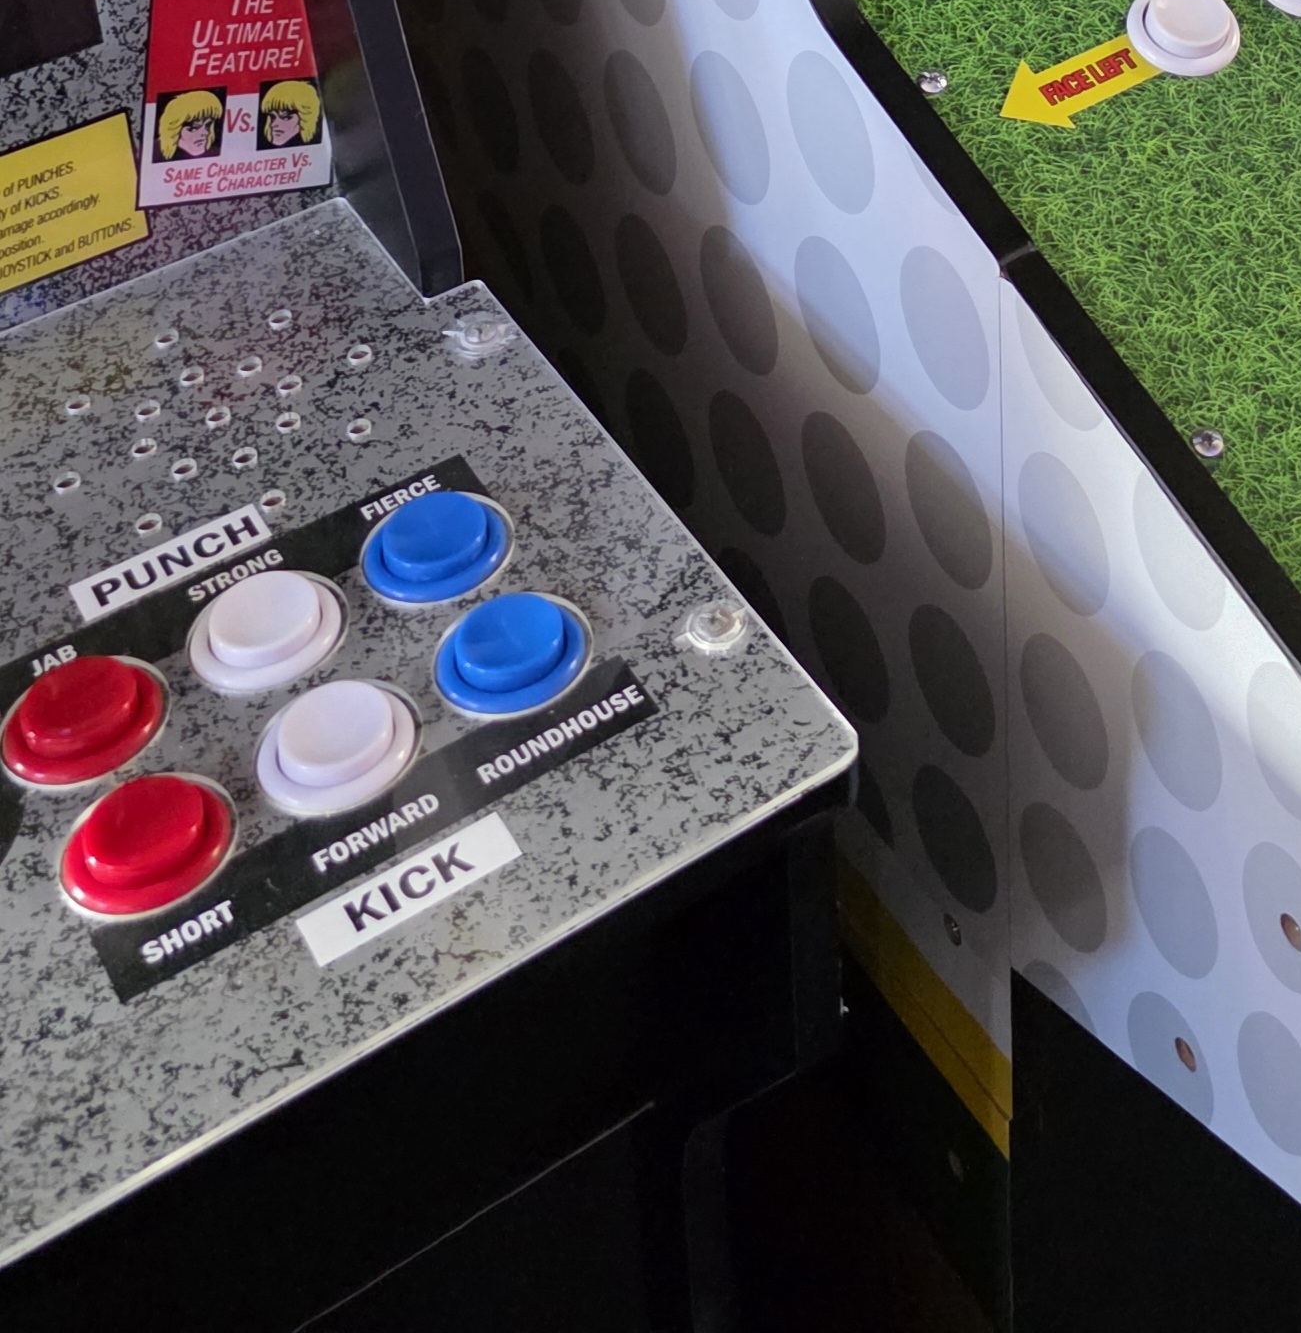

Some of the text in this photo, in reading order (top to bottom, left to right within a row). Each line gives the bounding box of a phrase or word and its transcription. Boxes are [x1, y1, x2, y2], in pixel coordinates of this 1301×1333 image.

[1039, 49, 1138, 106] FACE LEFT
[3, 181, 15, 197] of
[11, 200, 22, 215] of
[55, 240, 74, 258] and
[360, 474, 443, 521] FIERCE
[91, 514, 262, 609] PUNCH
[186, 549, 283, 604] STRONG
[30, 645, 79, 678] JAB
[476, 685, 645, 785] ROUNDHOUSE
[312, 794, 441, 874] FORWARD
[345, 844, 475, 933] KICK
[141, 901, 236, 966] SHORT
